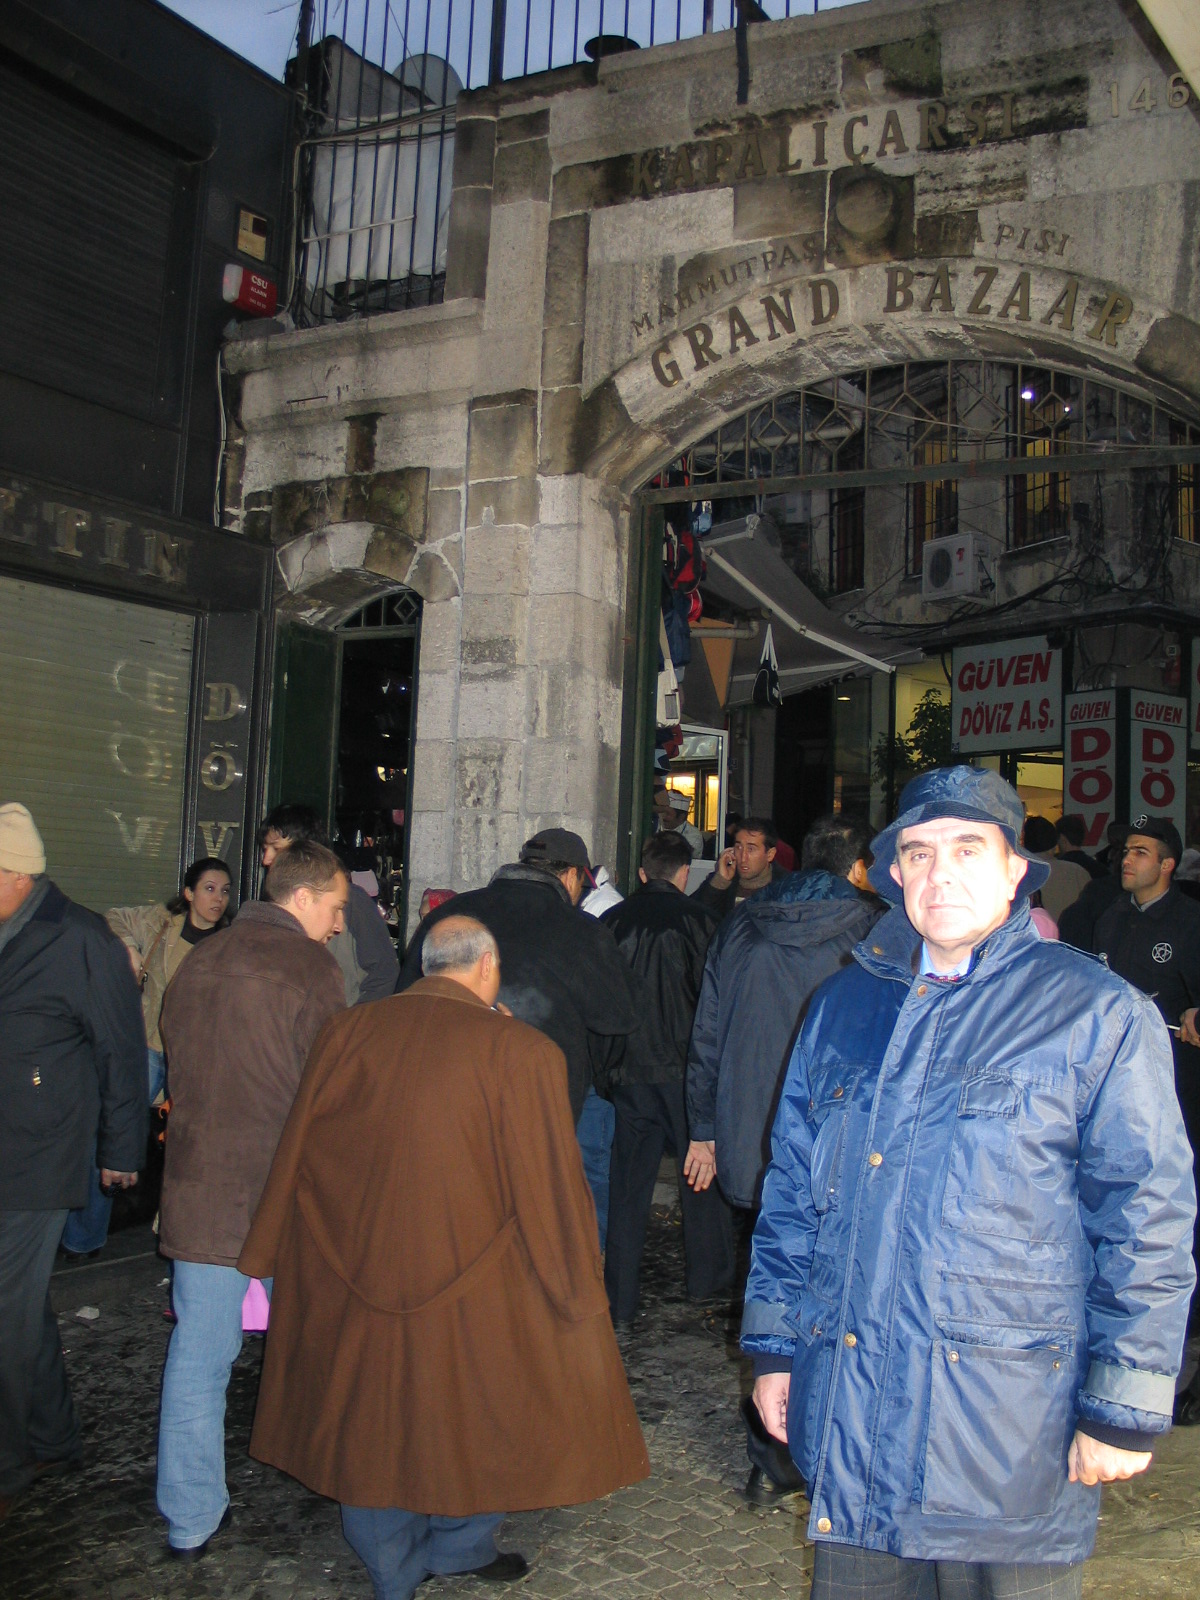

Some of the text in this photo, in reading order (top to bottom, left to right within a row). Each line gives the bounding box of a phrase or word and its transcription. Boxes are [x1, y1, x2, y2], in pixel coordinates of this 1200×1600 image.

[630, 92, 1020, 197] KAPALIÇARŞI
[251, 275, 268, 289] CSU
[651, 264, 1133, 388] GRAND BAZAAR
[958, 652, 1052, 692] GÜVEN
[1017, 698, 1054, 734] A.Ş.
[1070, 701, 1111, 722] GÜVEN
[1135, 701, 1183, 725] GÜVEN
[1140, 728, 1175, 826] DÖ
